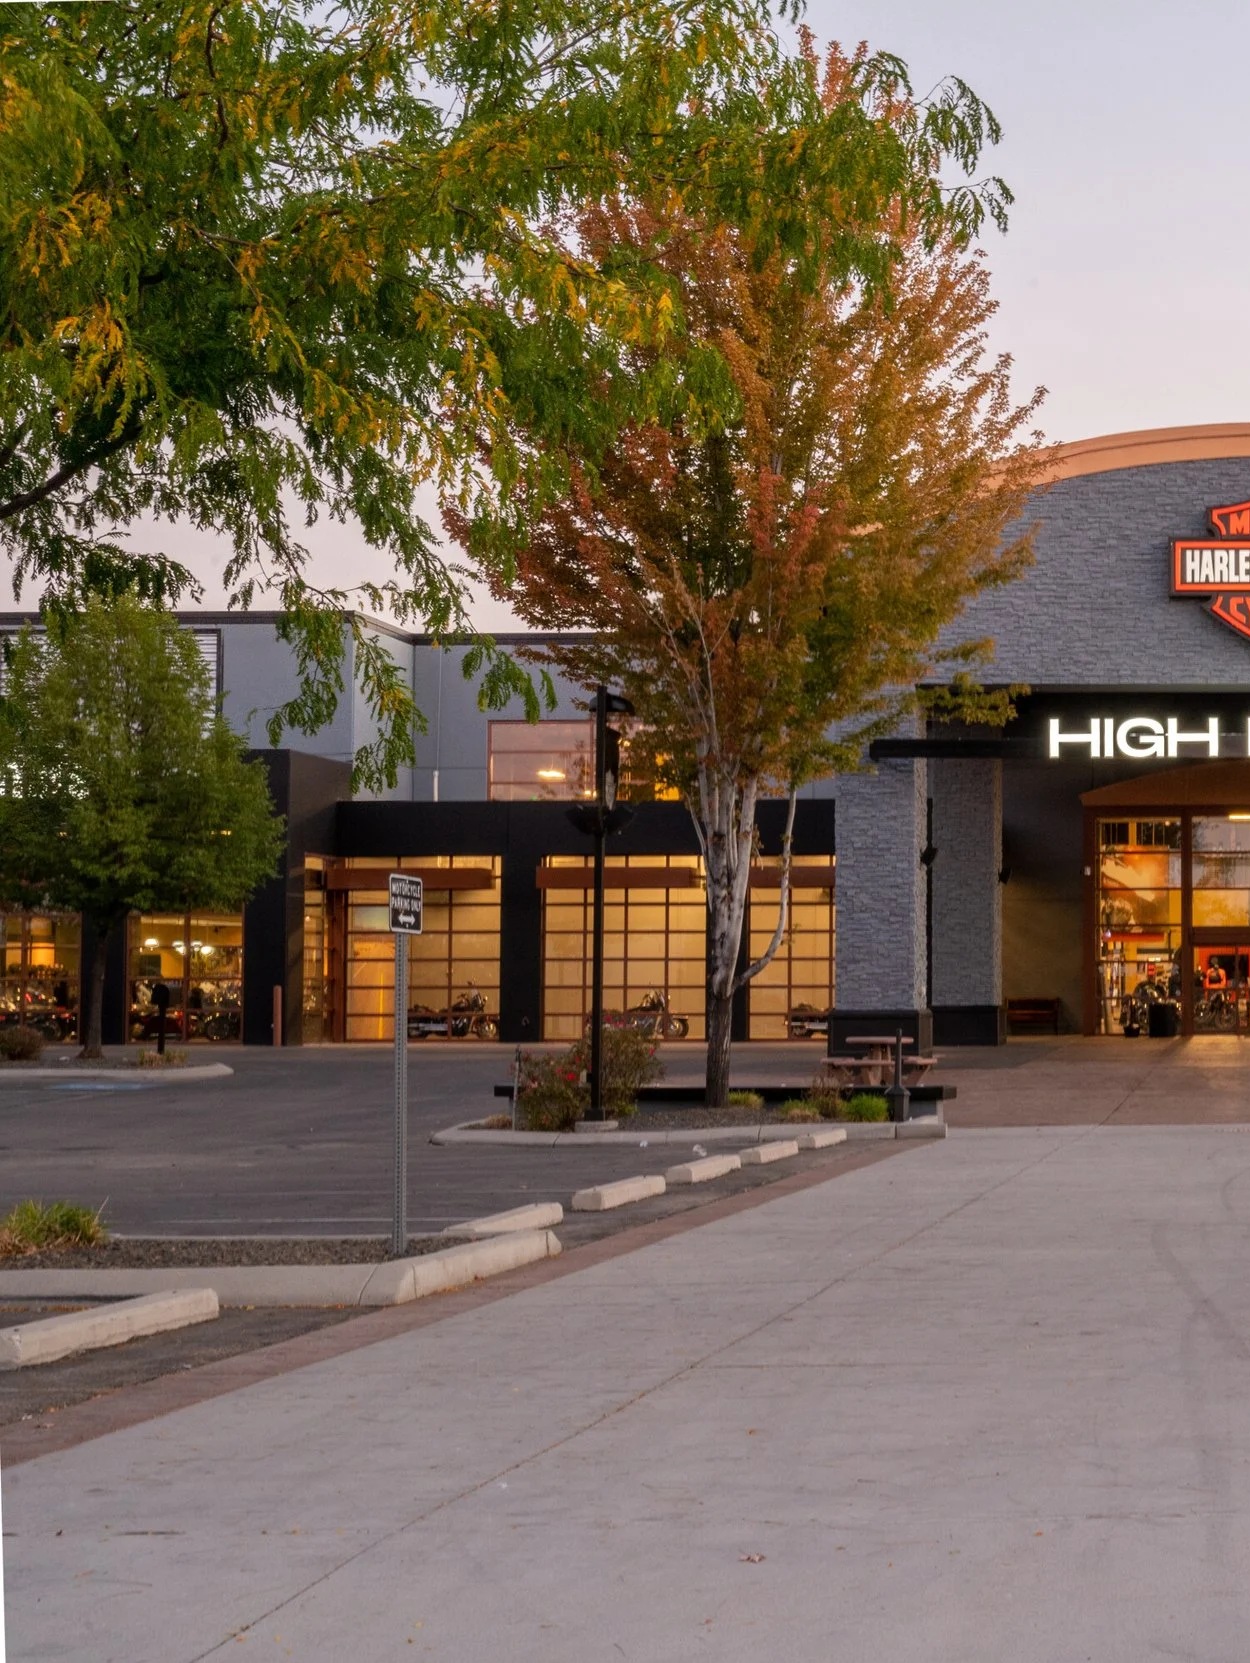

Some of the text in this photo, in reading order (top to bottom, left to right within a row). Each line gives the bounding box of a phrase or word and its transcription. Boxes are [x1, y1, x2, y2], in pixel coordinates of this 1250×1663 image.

[1049, 717, 1219, 758] HIGH
[392, 882, 420, 898] MOTORCYCLE
[391, 896, 421, 912] PARKING ONLY
